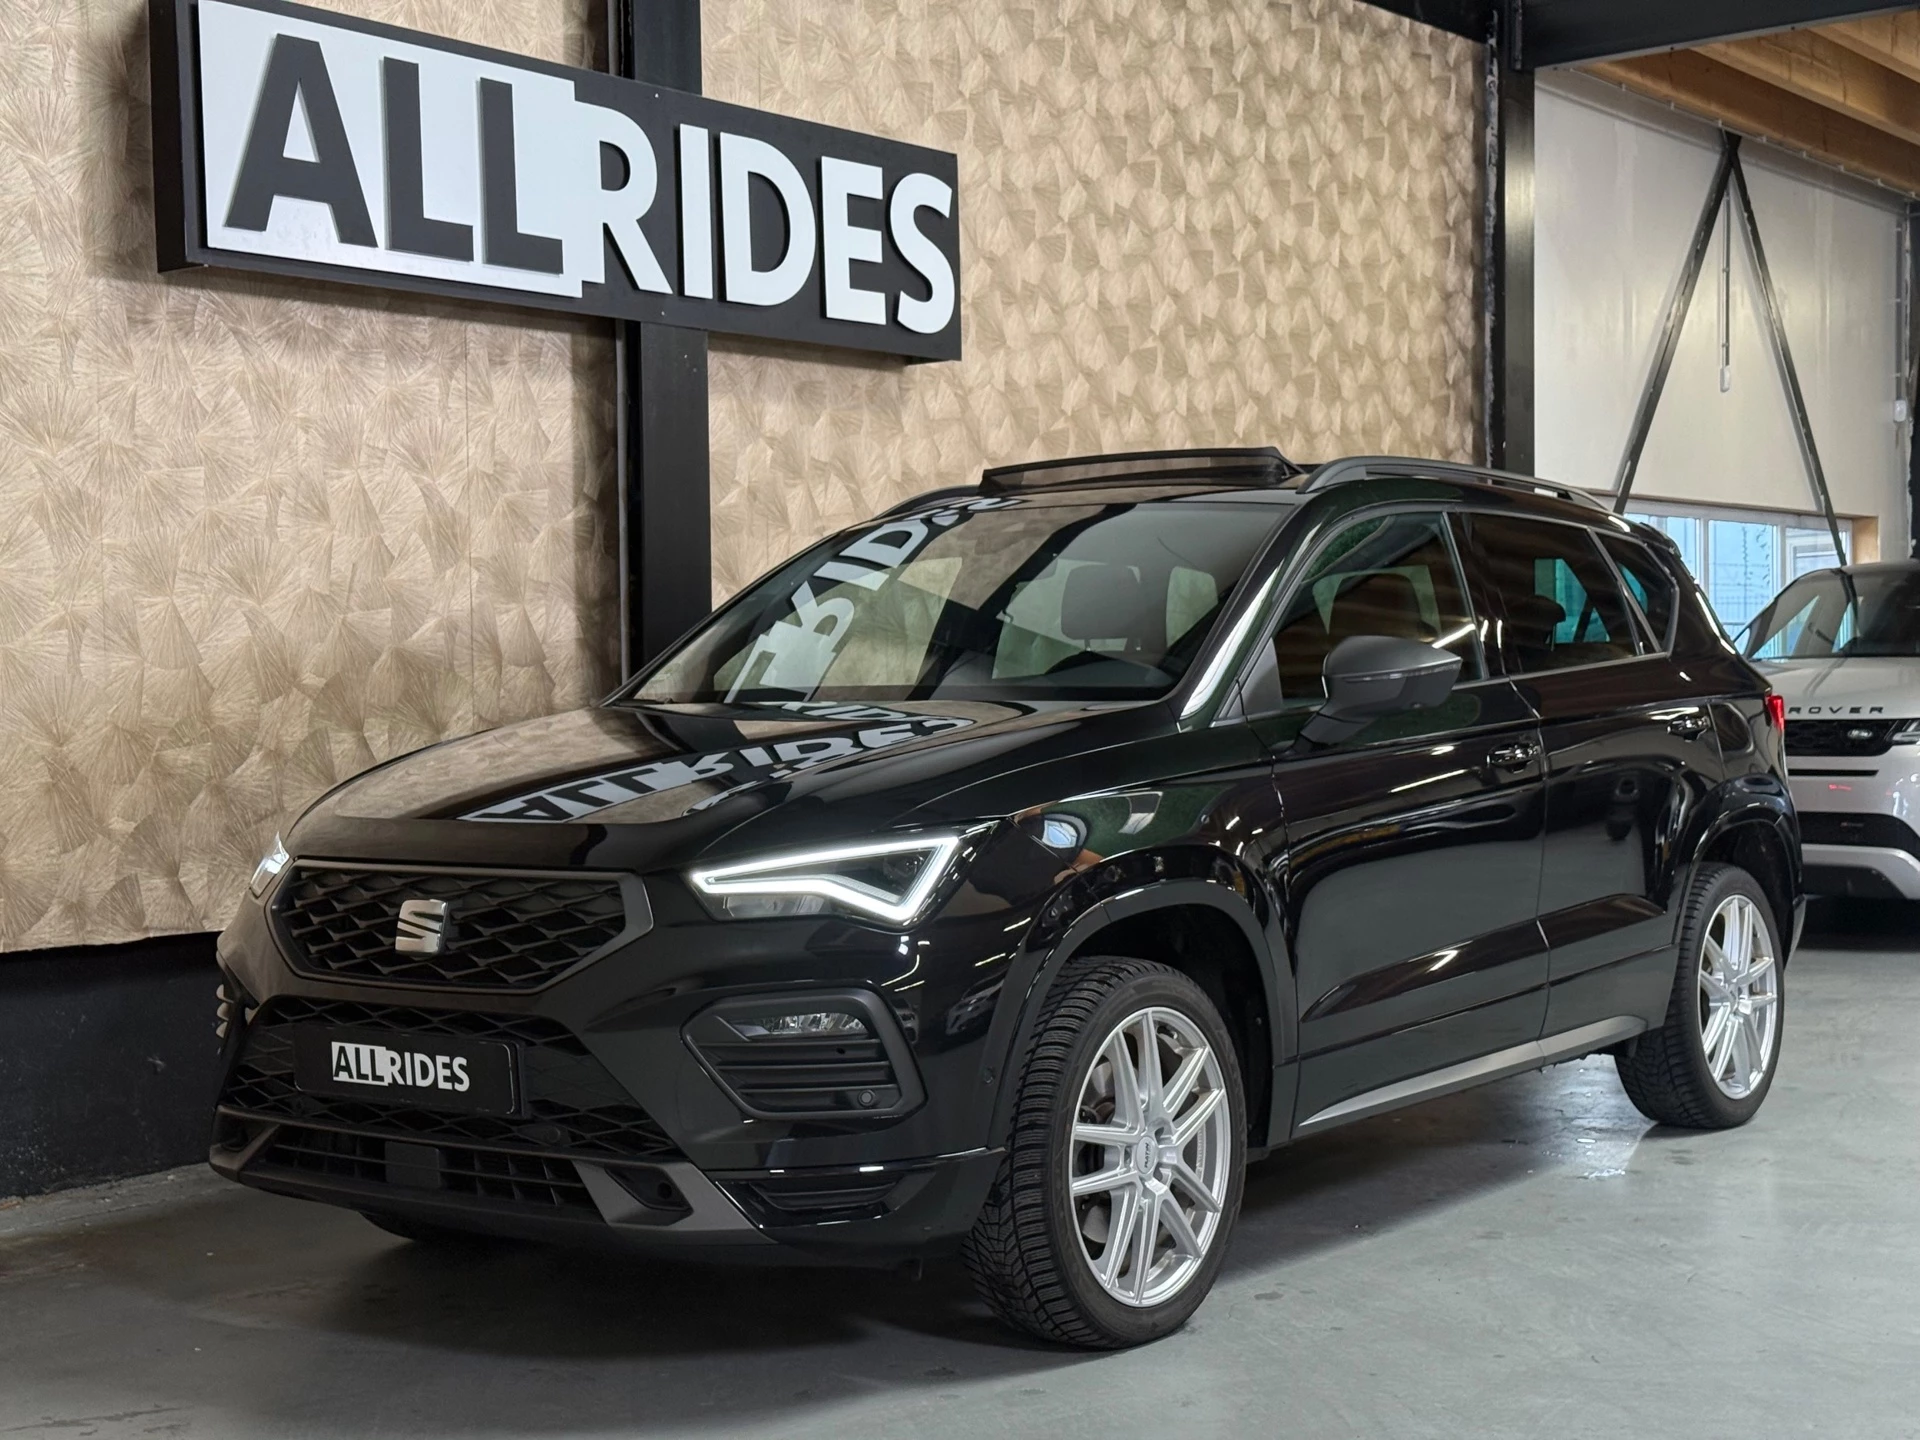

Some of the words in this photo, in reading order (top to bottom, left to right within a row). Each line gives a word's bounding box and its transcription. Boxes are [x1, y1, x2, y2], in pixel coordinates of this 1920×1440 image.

[222, 33, 956, 335] ALLRIDES
[1788, 706, 1884, 715] ROVER
[333, 1044, 470, 1092] ALLRIDES
